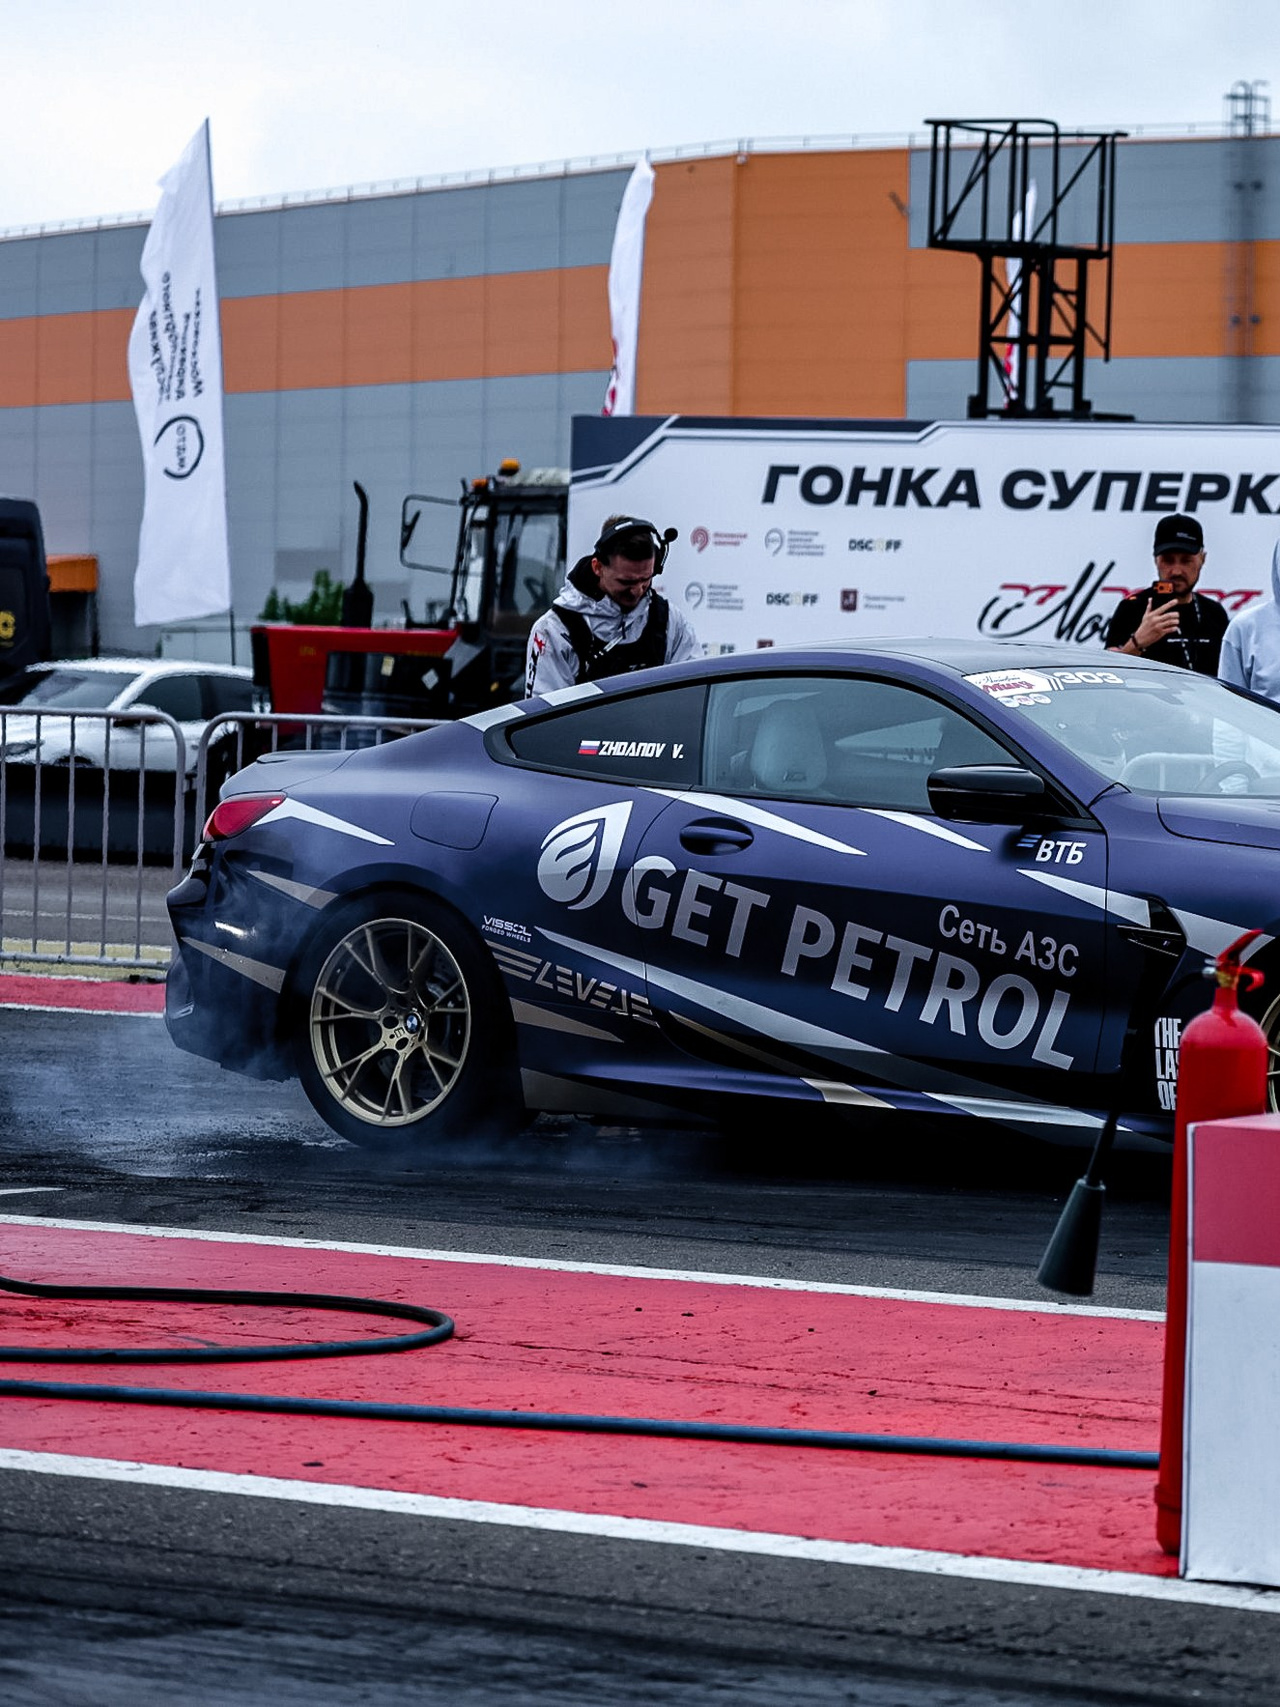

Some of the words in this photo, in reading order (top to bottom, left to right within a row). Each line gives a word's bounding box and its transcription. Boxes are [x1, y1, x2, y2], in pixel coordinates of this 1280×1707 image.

[762, 465, 981, 508] ГОНКА
[1053, 672, 1125, 684] 303
[672, 744, 684, 759] V.
[1035, 839, 1087, 865] ВТБ
[506, 930, 532, 943] WHEELS
[938, 904, 1007, 955] Сеть
[1014, 930, 1080, 977] АЗС
[621, 855, 771, 958] GET
[780, 904, 1075, 1071] PETROL
